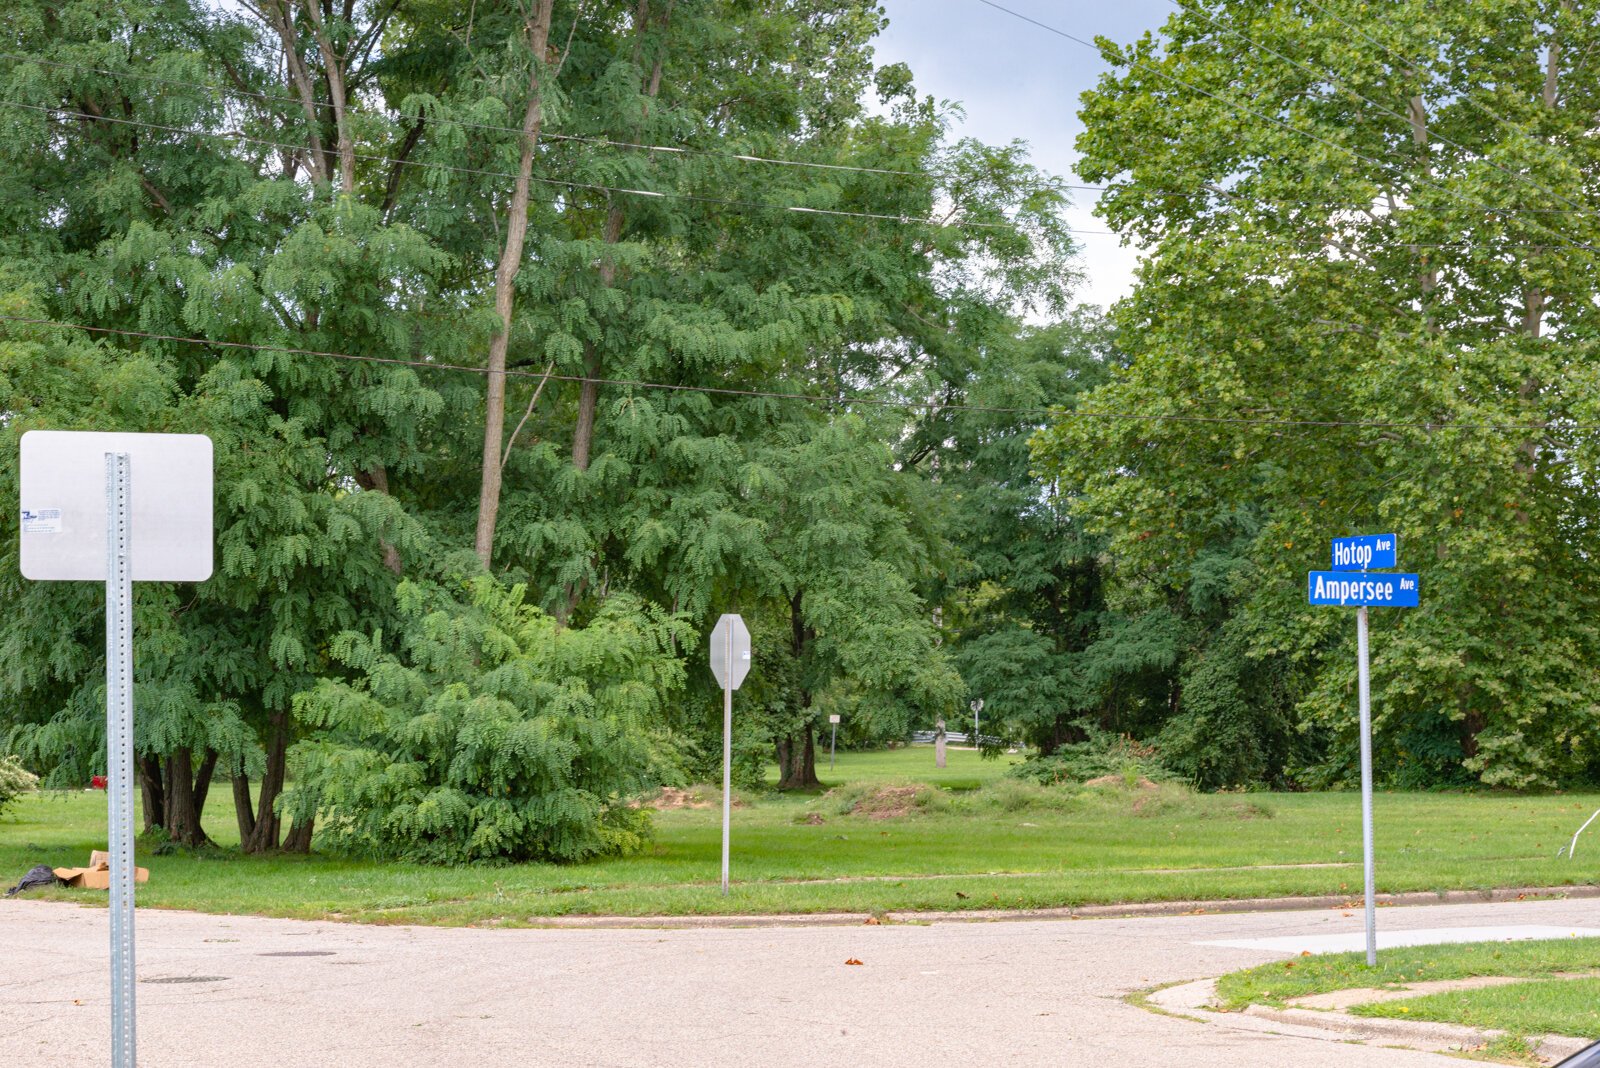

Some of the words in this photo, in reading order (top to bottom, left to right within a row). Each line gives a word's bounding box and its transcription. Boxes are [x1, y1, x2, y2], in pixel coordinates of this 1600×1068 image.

[1335, 541, 1372, 569] Hotop
[1376, 539, 1391, 551] Ave
[1314, 575, 1393, 606] Ampersee
[1400, 578, 1414, 590] Ave
